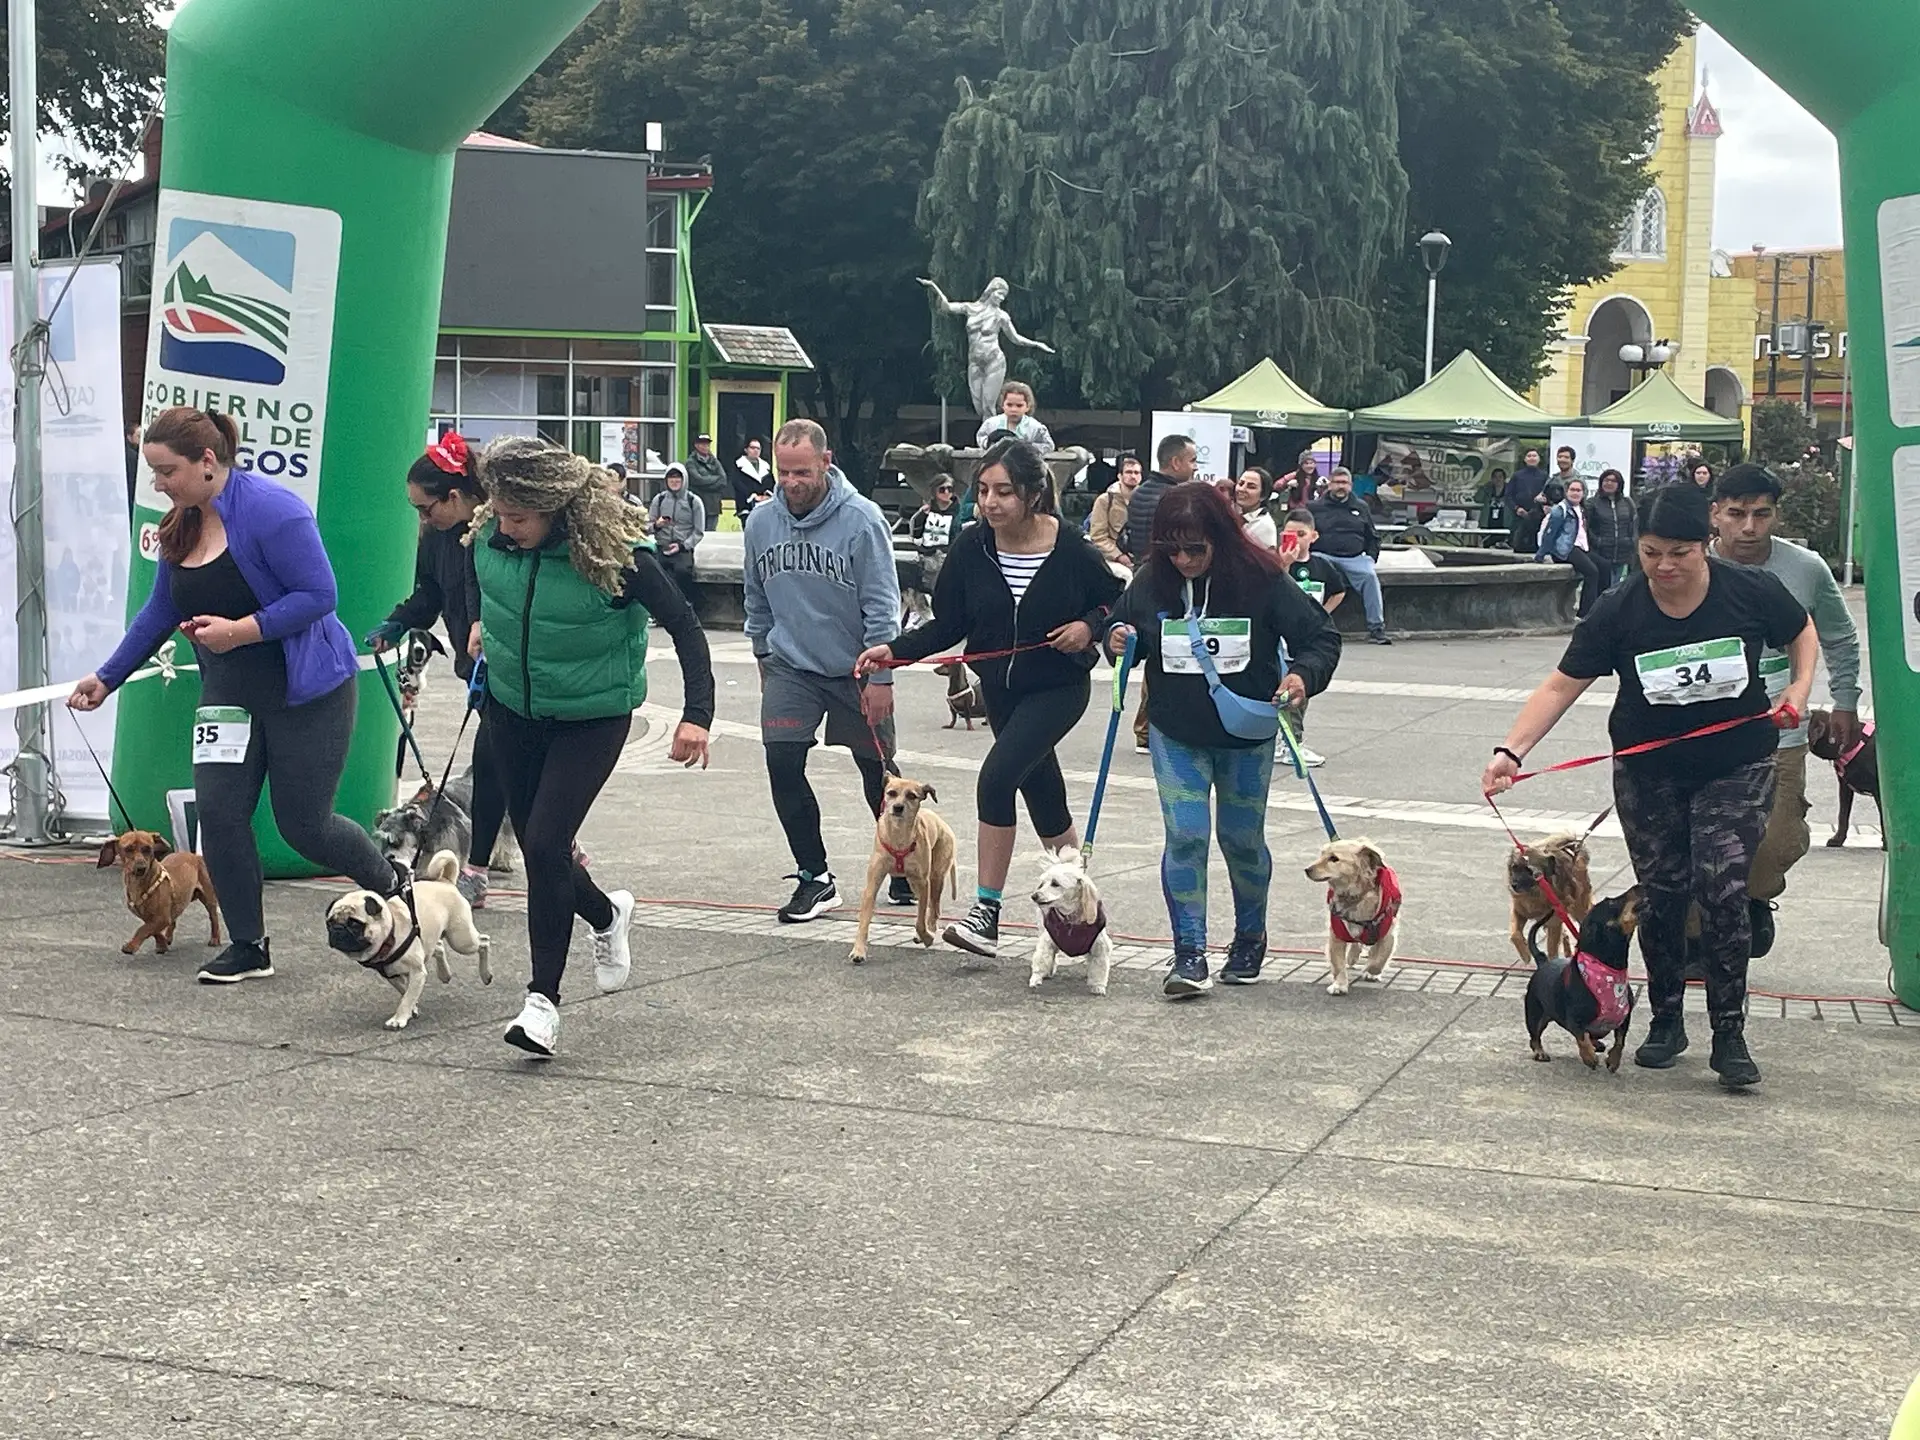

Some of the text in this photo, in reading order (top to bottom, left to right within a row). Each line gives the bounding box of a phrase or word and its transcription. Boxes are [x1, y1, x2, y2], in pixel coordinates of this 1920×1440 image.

[146, 381, 313, 423] GOBIERNO
[270, 426, 312, 448] DE
[236, 446, 309, 478] GOS
[1428, 450, 1444, 463] YO
[1576, 461, 1610, 472] CASTRO
[1675, 663, 1712, 687] 34
[196, 725, 219, 745] 35
